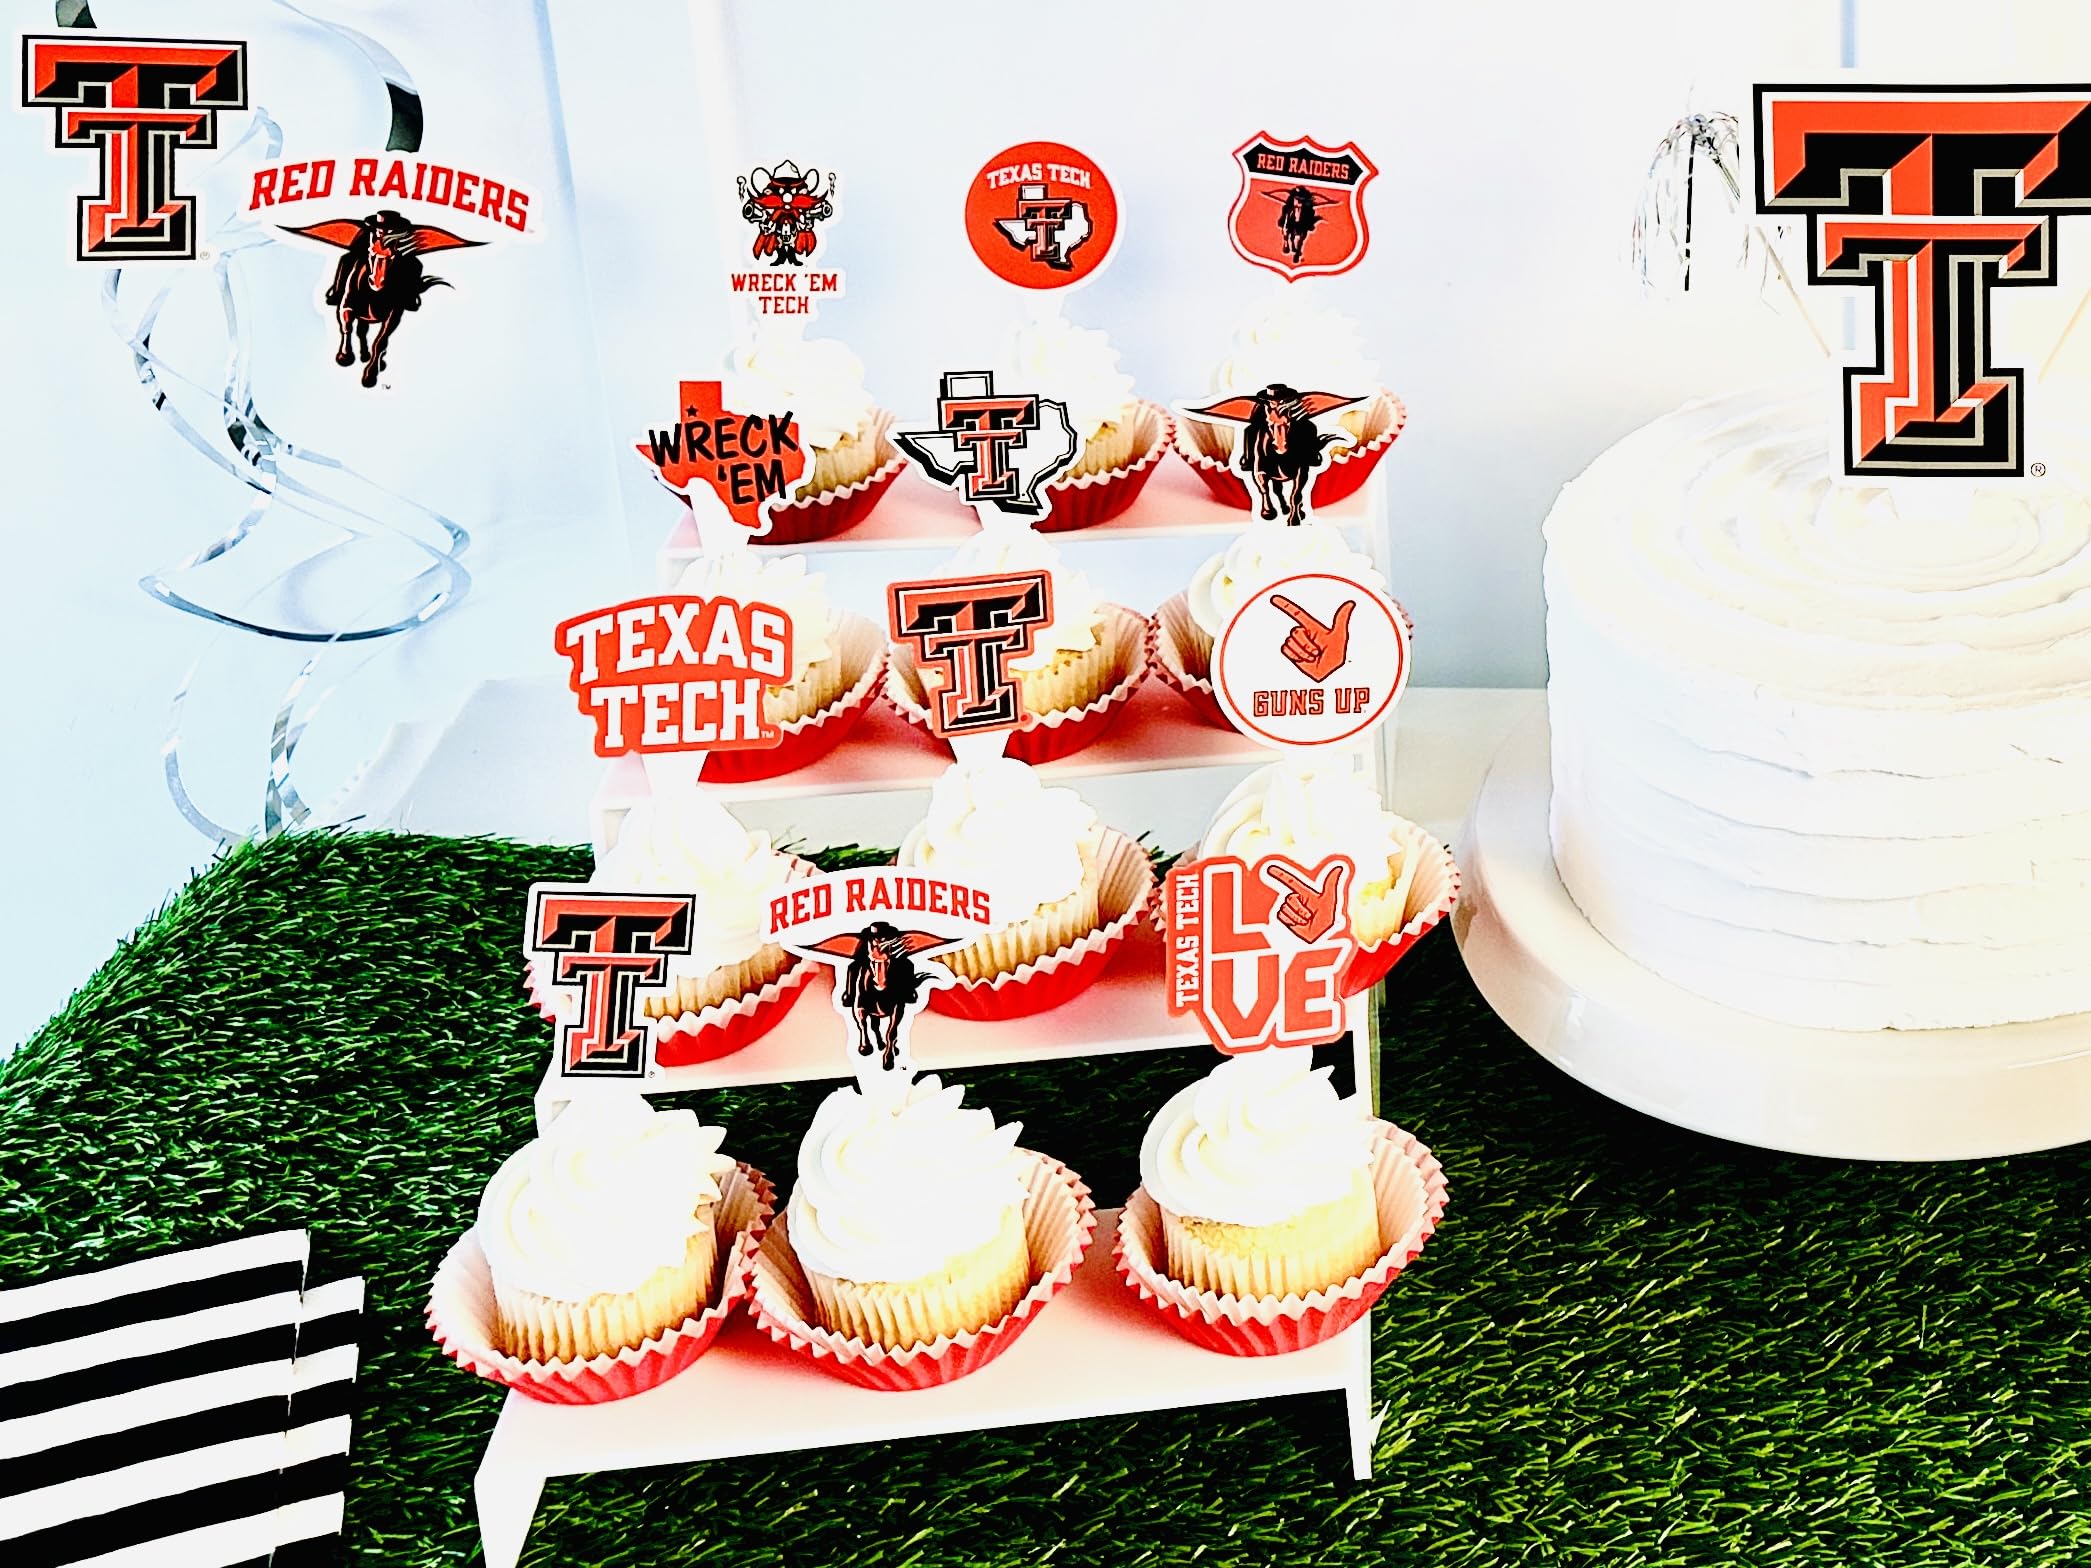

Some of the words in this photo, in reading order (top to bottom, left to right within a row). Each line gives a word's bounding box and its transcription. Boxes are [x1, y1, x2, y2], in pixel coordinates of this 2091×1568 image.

[986, 163, 1043, 189] TEXAS
[1047, 163, 1091, 189] TECH
[1256, 153, 1285, 171] RED
[1288, 157, 1350, 180] RAIDERS
[249, 160, 335, 211] RED
[350, 158, 529, 232] RAIDERS
[731, 273, 797, 292] WRECK
[804, 273, 838, 292] 'EM
[758, 296, 809, 314] TECH
[648, 410, 799, 467] WRECK
[717, 459, 787, 505] 'EM
[566, 603, 786, 685] TEXAS
[591, 678, 761, 748] TECH
[1253, 690, 1324, 717] GUNS
[1335, 687, 1370, 714] UP
[770, 883, 831, 934] RED
[846, 877, 990, 925] RAIDERS
[1176, 874, 1199, 930] TECH
[1176, 935, 1199, 1008] TEXAS
